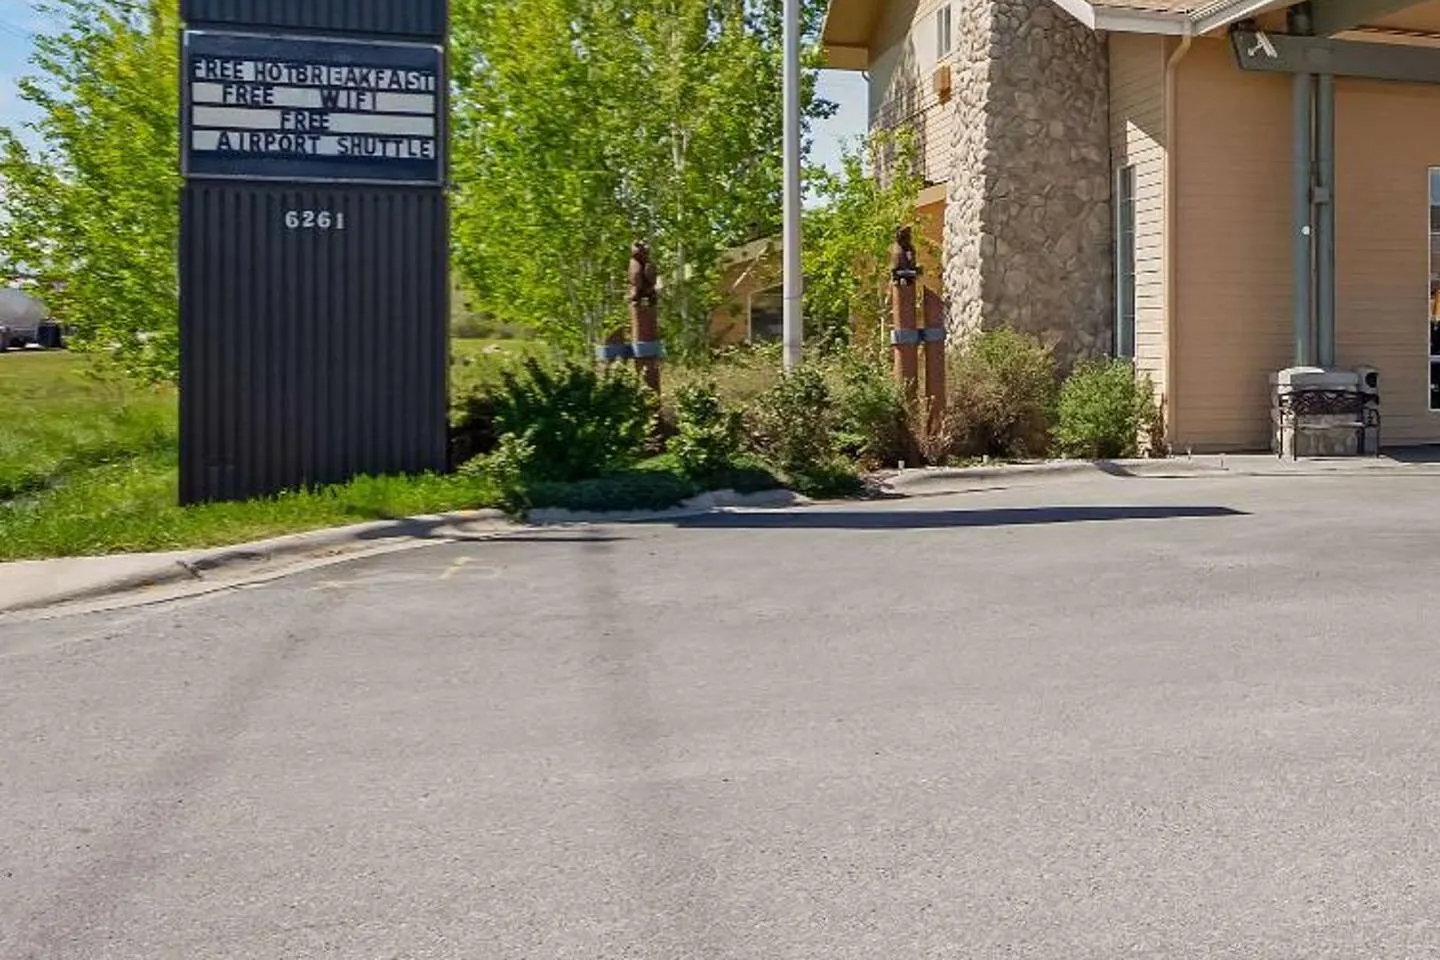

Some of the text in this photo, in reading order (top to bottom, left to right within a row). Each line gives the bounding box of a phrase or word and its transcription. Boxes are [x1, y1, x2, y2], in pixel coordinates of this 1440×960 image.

[194, 59, 246, 80] FREE
[222, 86, 377, 111] FREE WIFI
[280, 112, 331, 131] FREE
[216, 131, 431, 159] AIRPORT SHUTTLE
[285, 210, 345, 230] 6261
